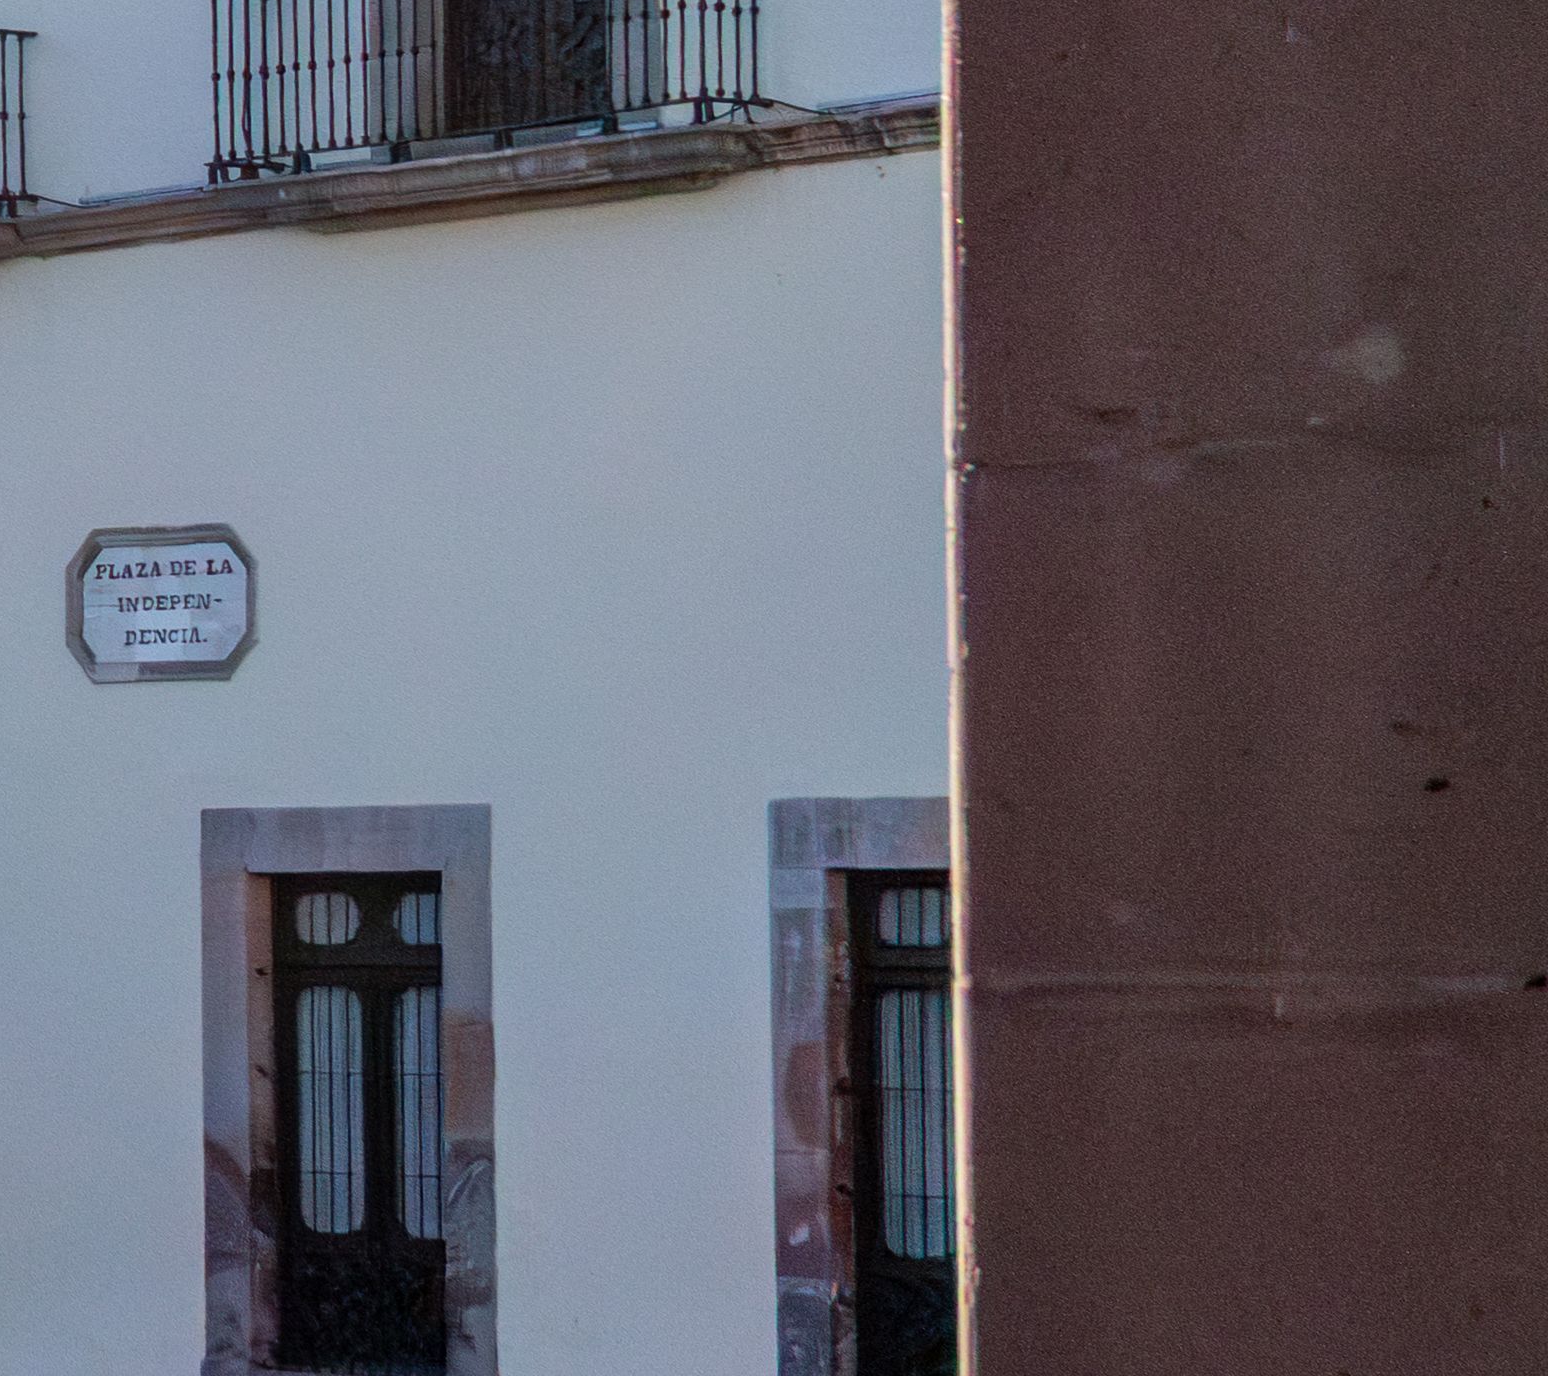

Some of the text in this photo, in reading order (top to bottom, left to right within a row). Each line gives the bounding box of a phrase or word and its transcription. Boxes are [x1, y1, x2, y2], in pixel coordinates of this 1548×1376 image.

[94, 558, 234, 580] PLAZA DE LA
[117, 593, 223, 613] INDEPEN-
[124, 627, 208, 647] DENCIA.
